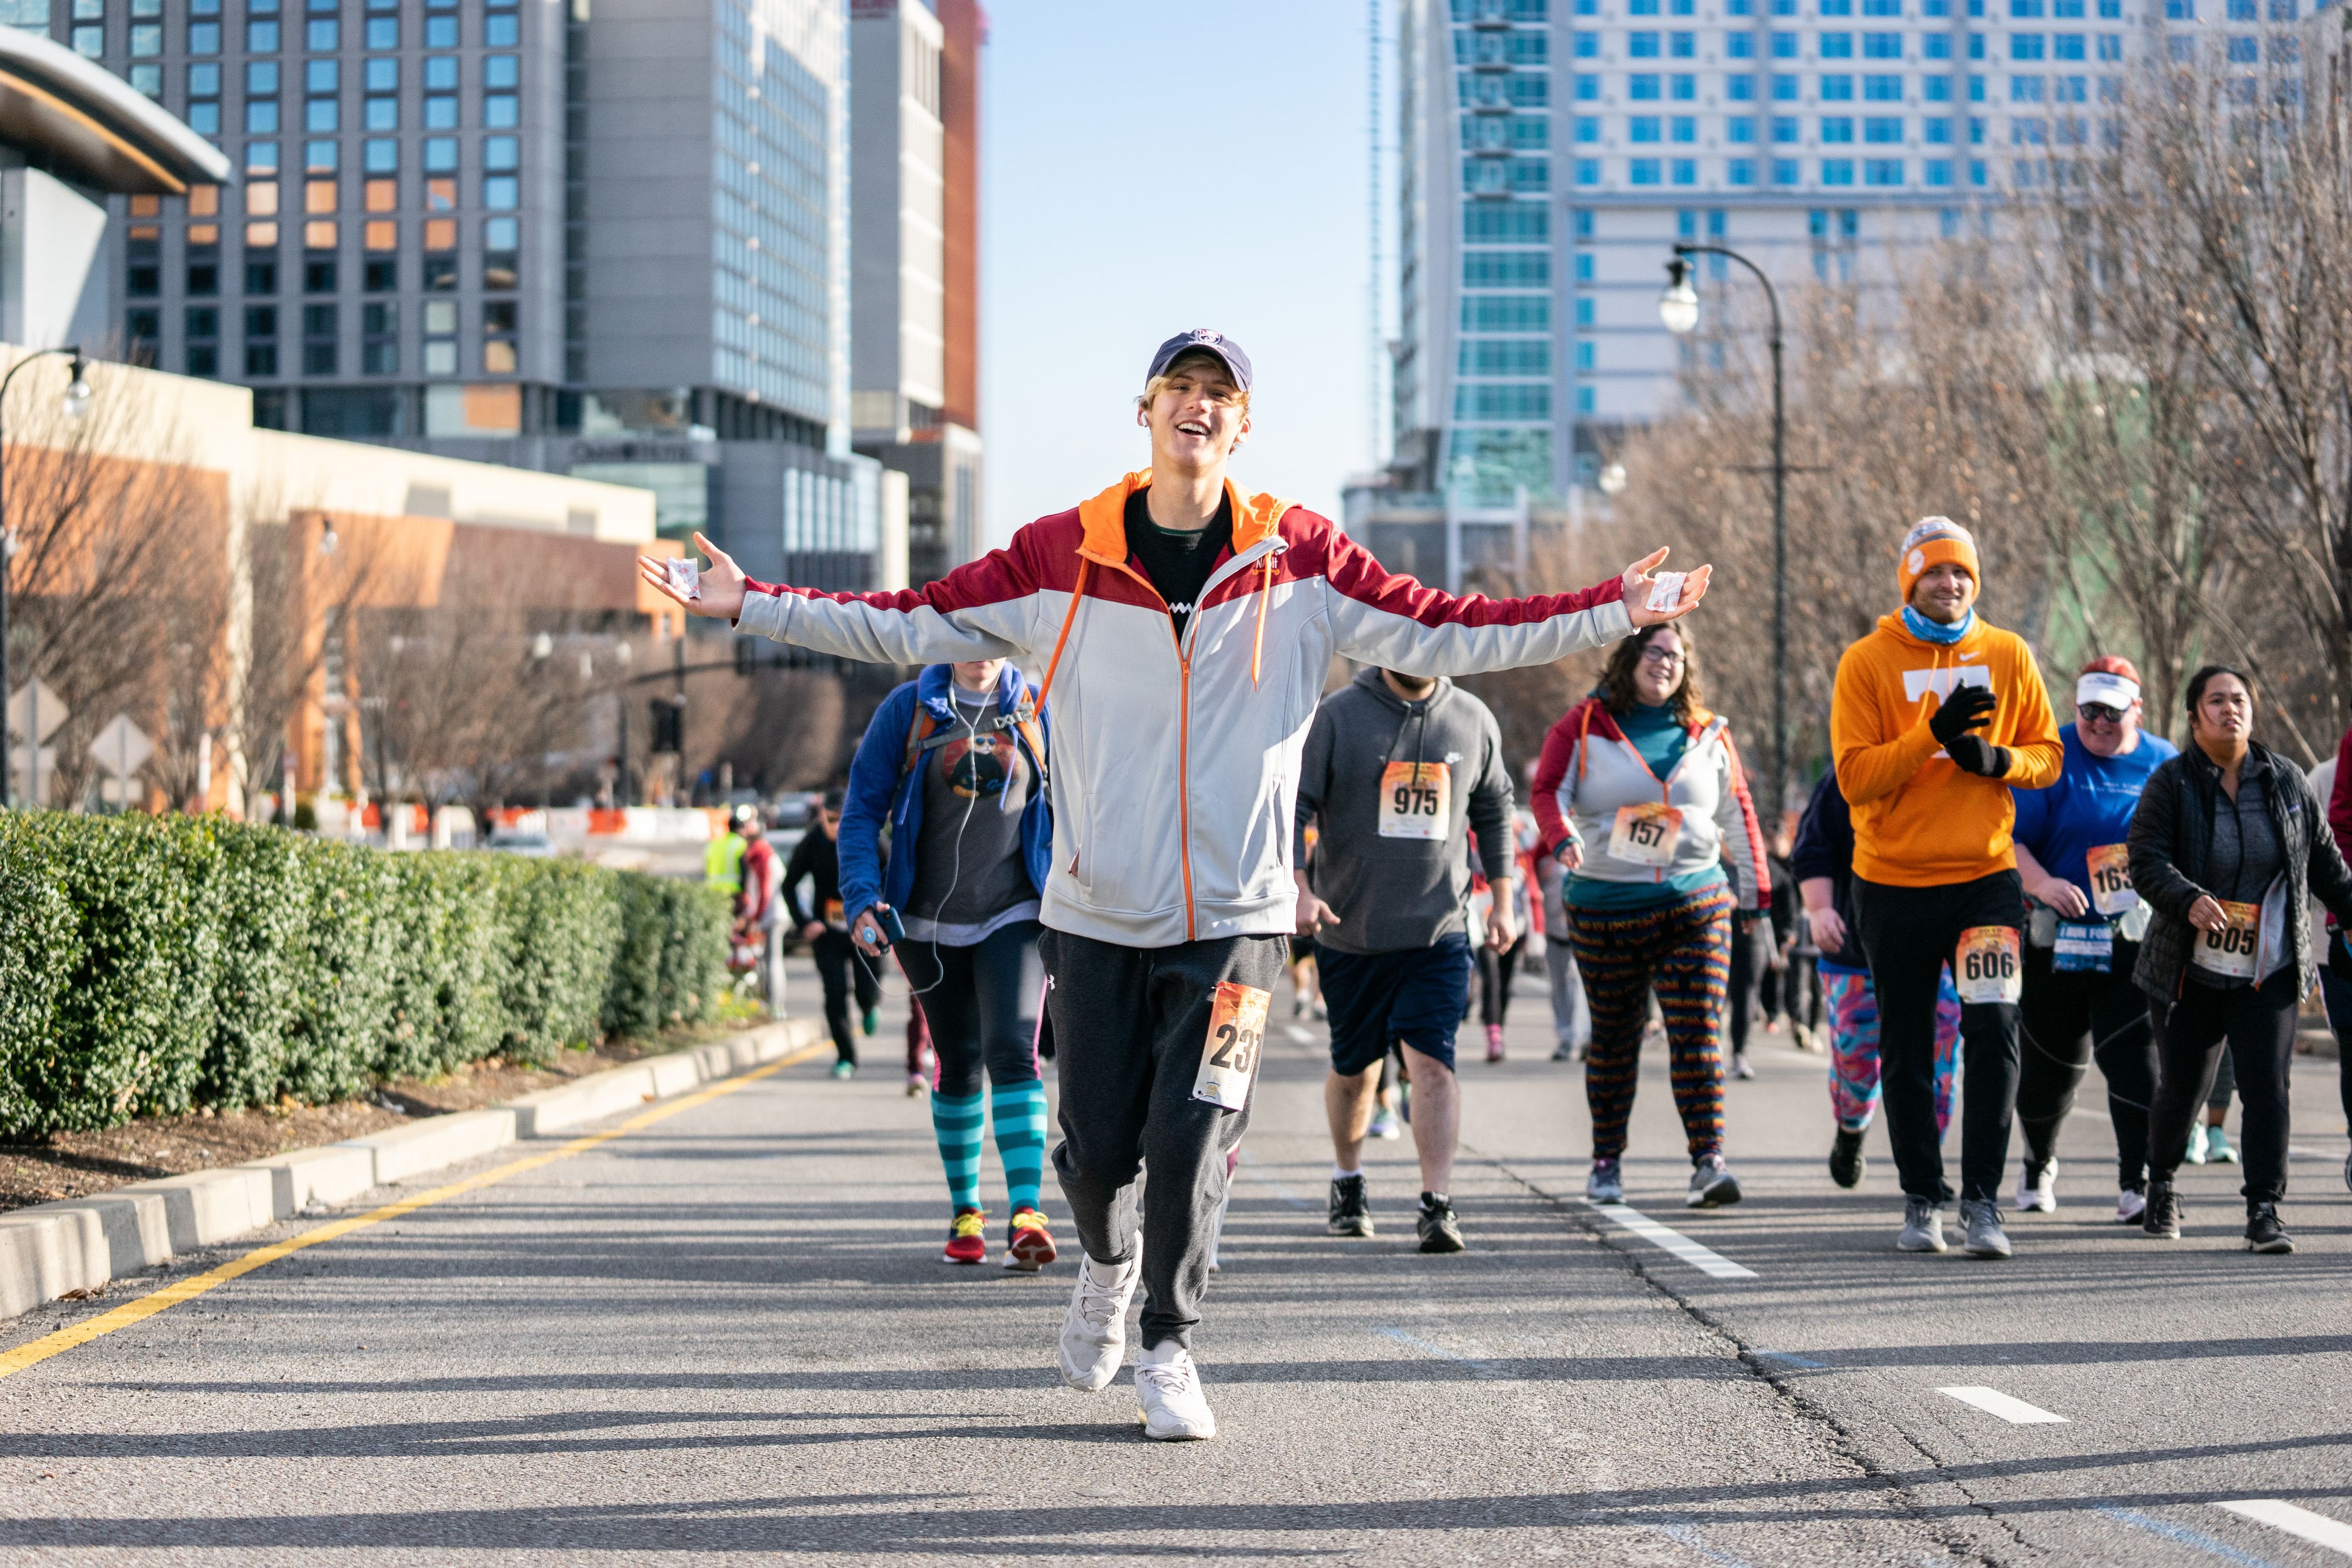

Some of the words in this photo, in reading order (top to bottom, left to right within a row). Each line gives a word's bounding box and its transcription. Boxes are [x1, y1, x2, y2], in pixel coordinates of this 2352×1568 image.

[1256, 557, 1278, 569] NH
[1394, 787, 1438, 816] 975
[1629, 818, 1665, 847] 157
[2207, 927, 2256, 955] 605
[1965, 951, 2014, 981] 606
